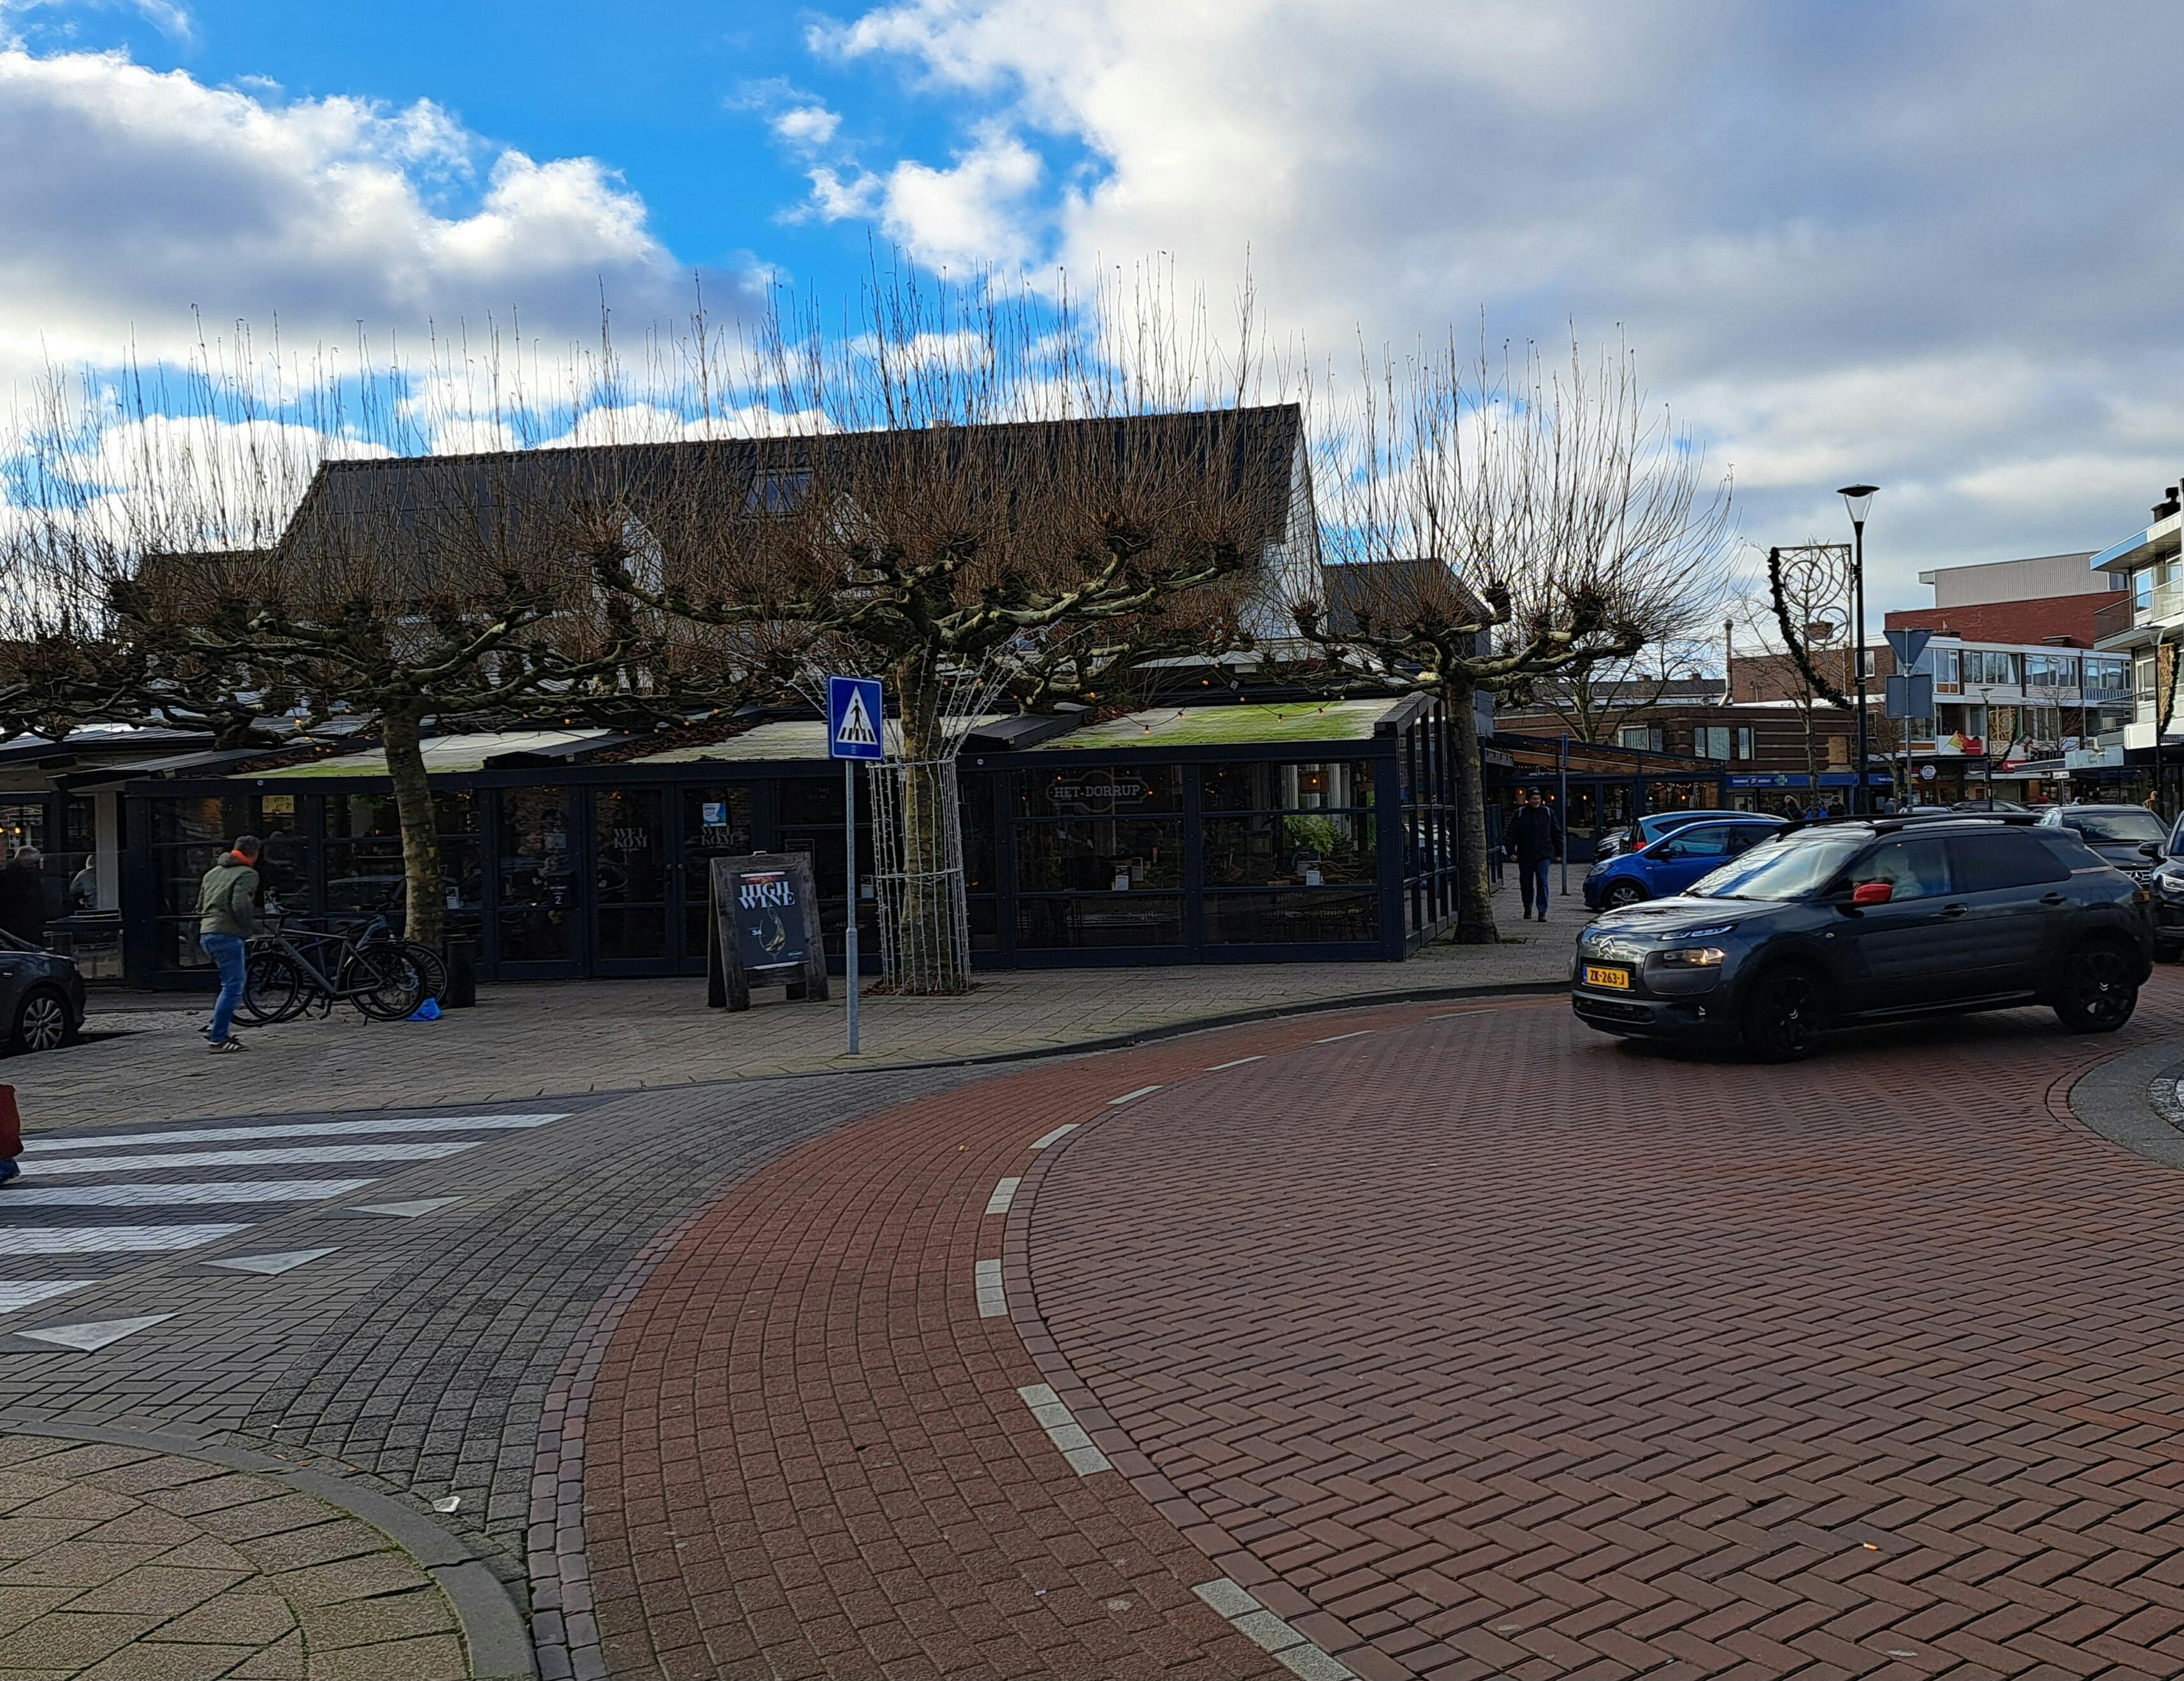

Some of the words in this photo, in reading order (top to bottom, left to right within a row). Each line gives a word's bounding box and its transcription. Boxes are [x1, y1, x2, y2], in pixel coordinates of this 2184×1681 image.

[1054, 787, 1080, 797] HET
[1085, 785, 1140, 797] DORRUP
[740, 881, 791, 898] HIGH
[554, 896, 562, 904] 2
[738, 892, 795, 910] WINE
[1590, 970, 1624, 986] ZK-263-J
